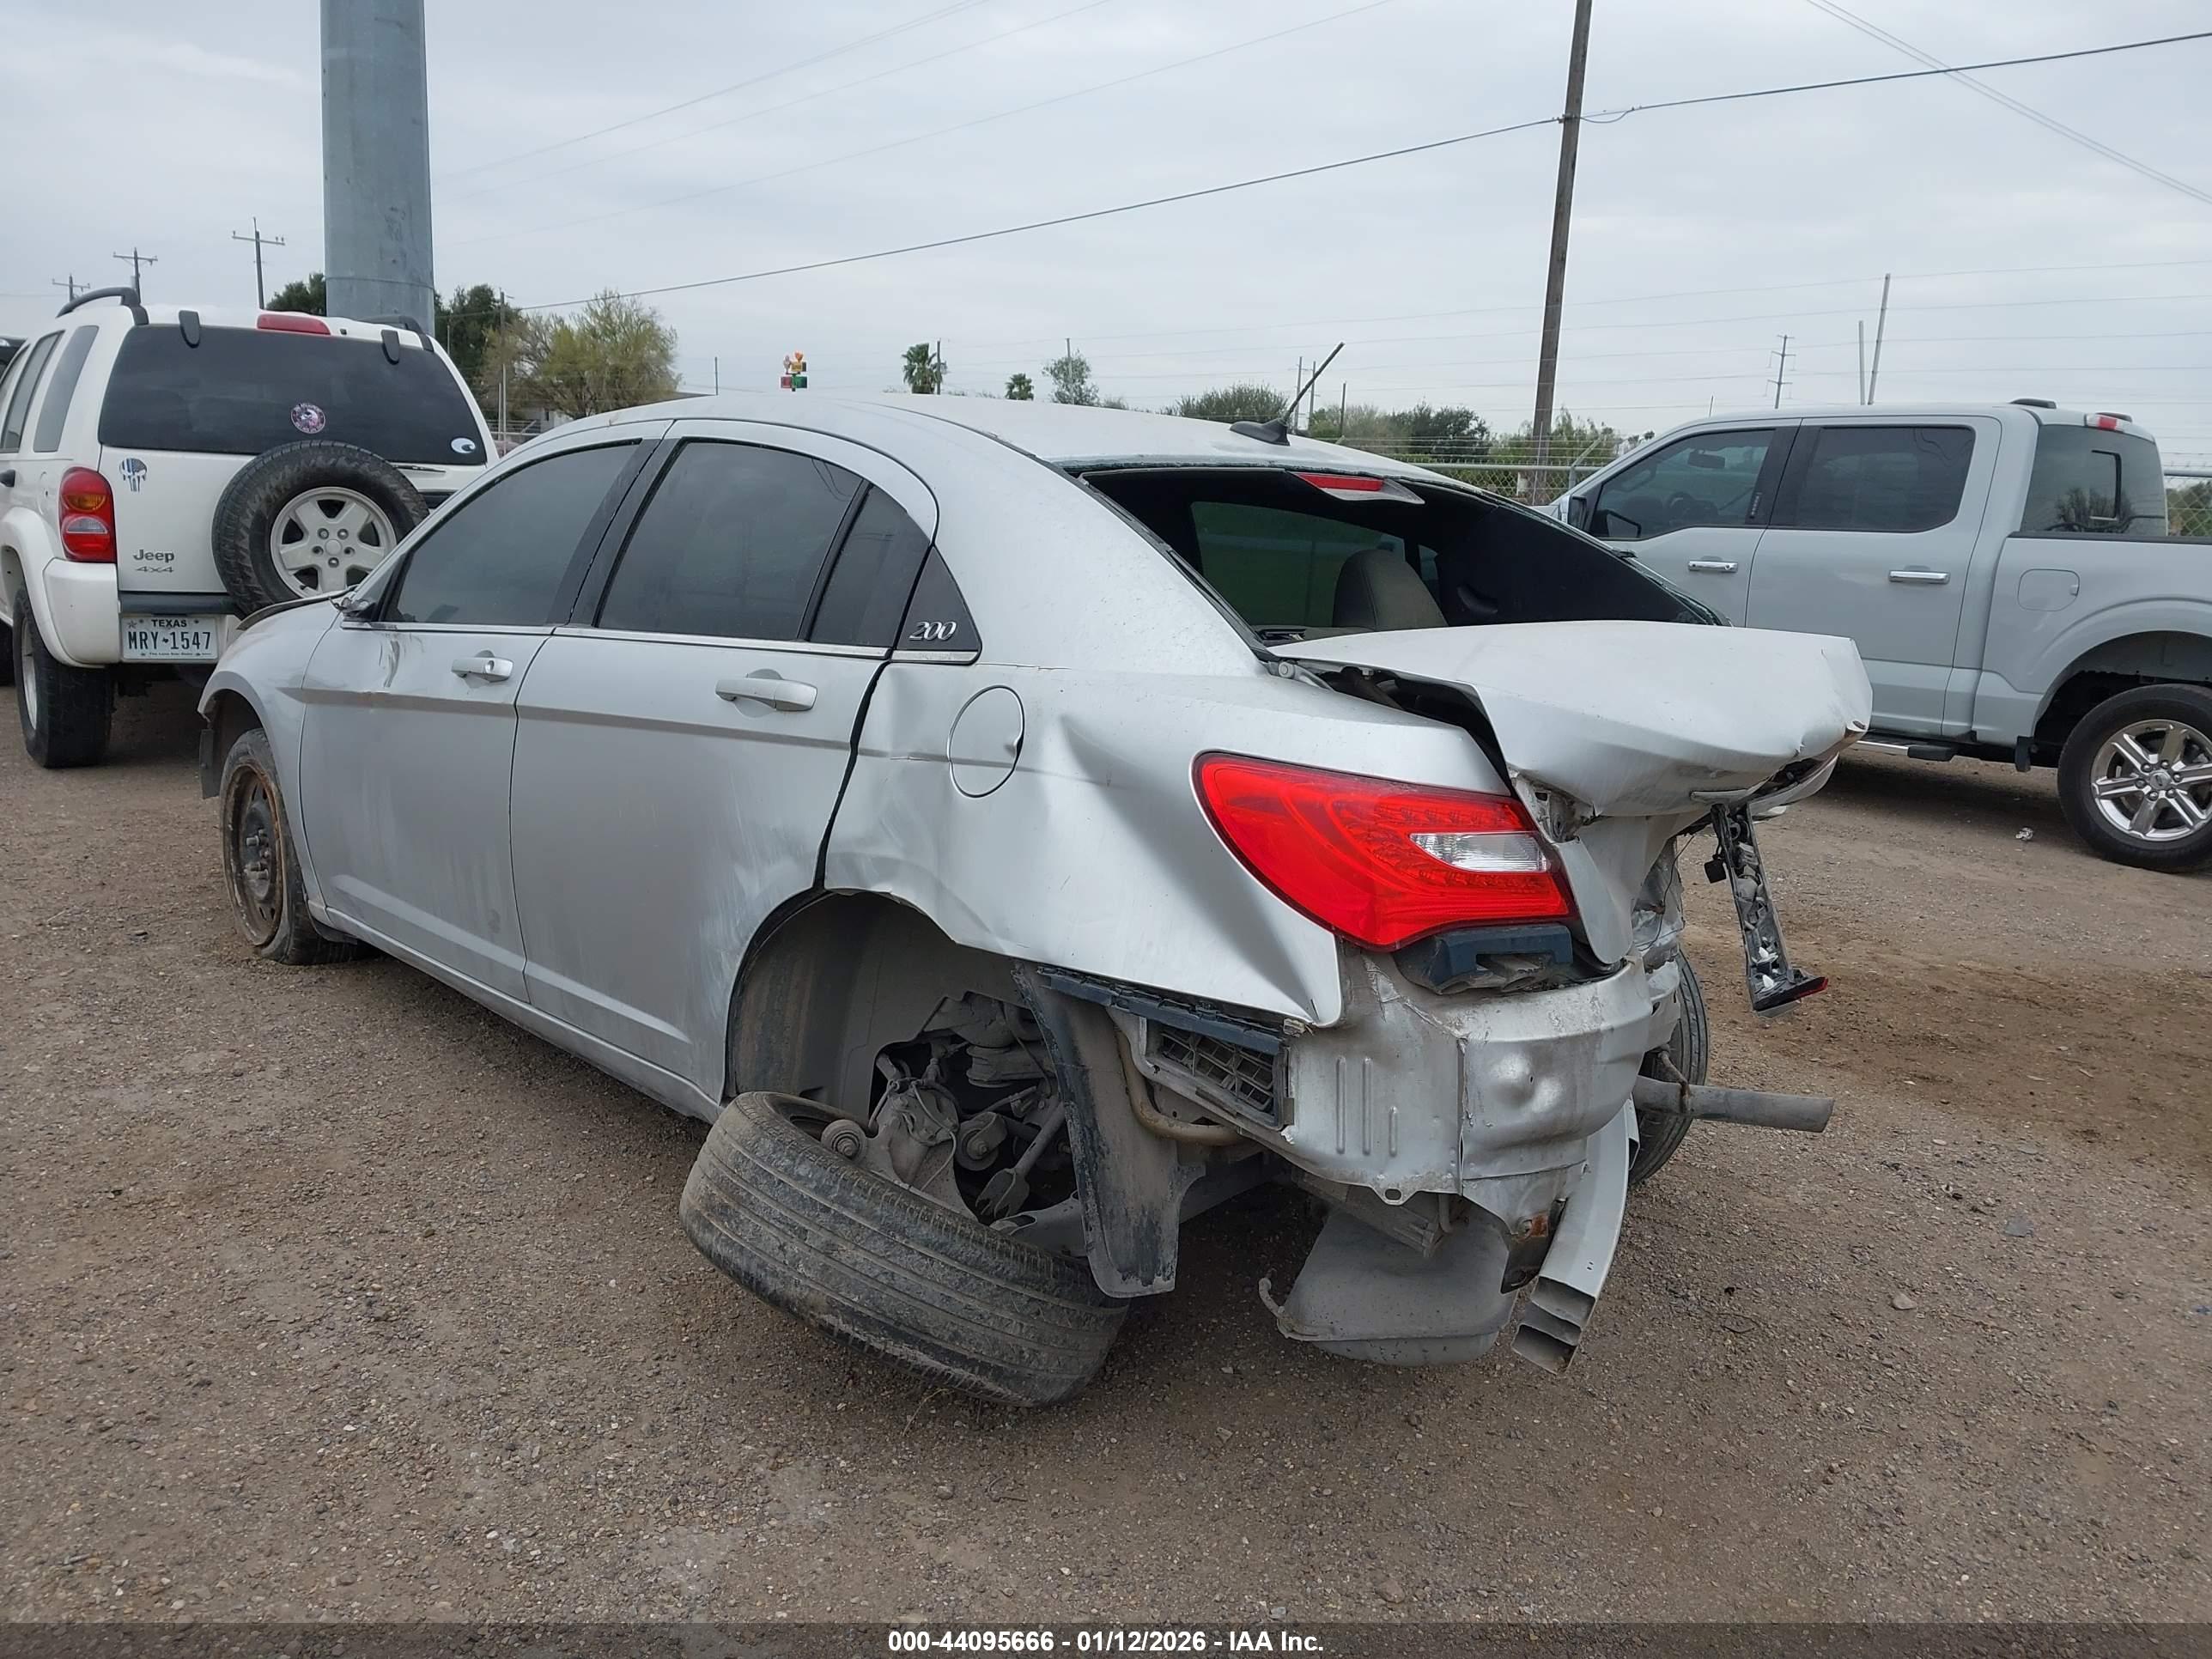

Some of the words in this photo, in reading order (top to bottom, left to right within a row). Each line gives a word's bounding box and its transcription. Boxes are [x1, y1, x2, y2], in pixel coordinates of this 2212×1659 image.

[132, 549, 175, 563] Jeep
[151, 619, 188, 628] TEXAS
[909, 621, 957, 641] 200
